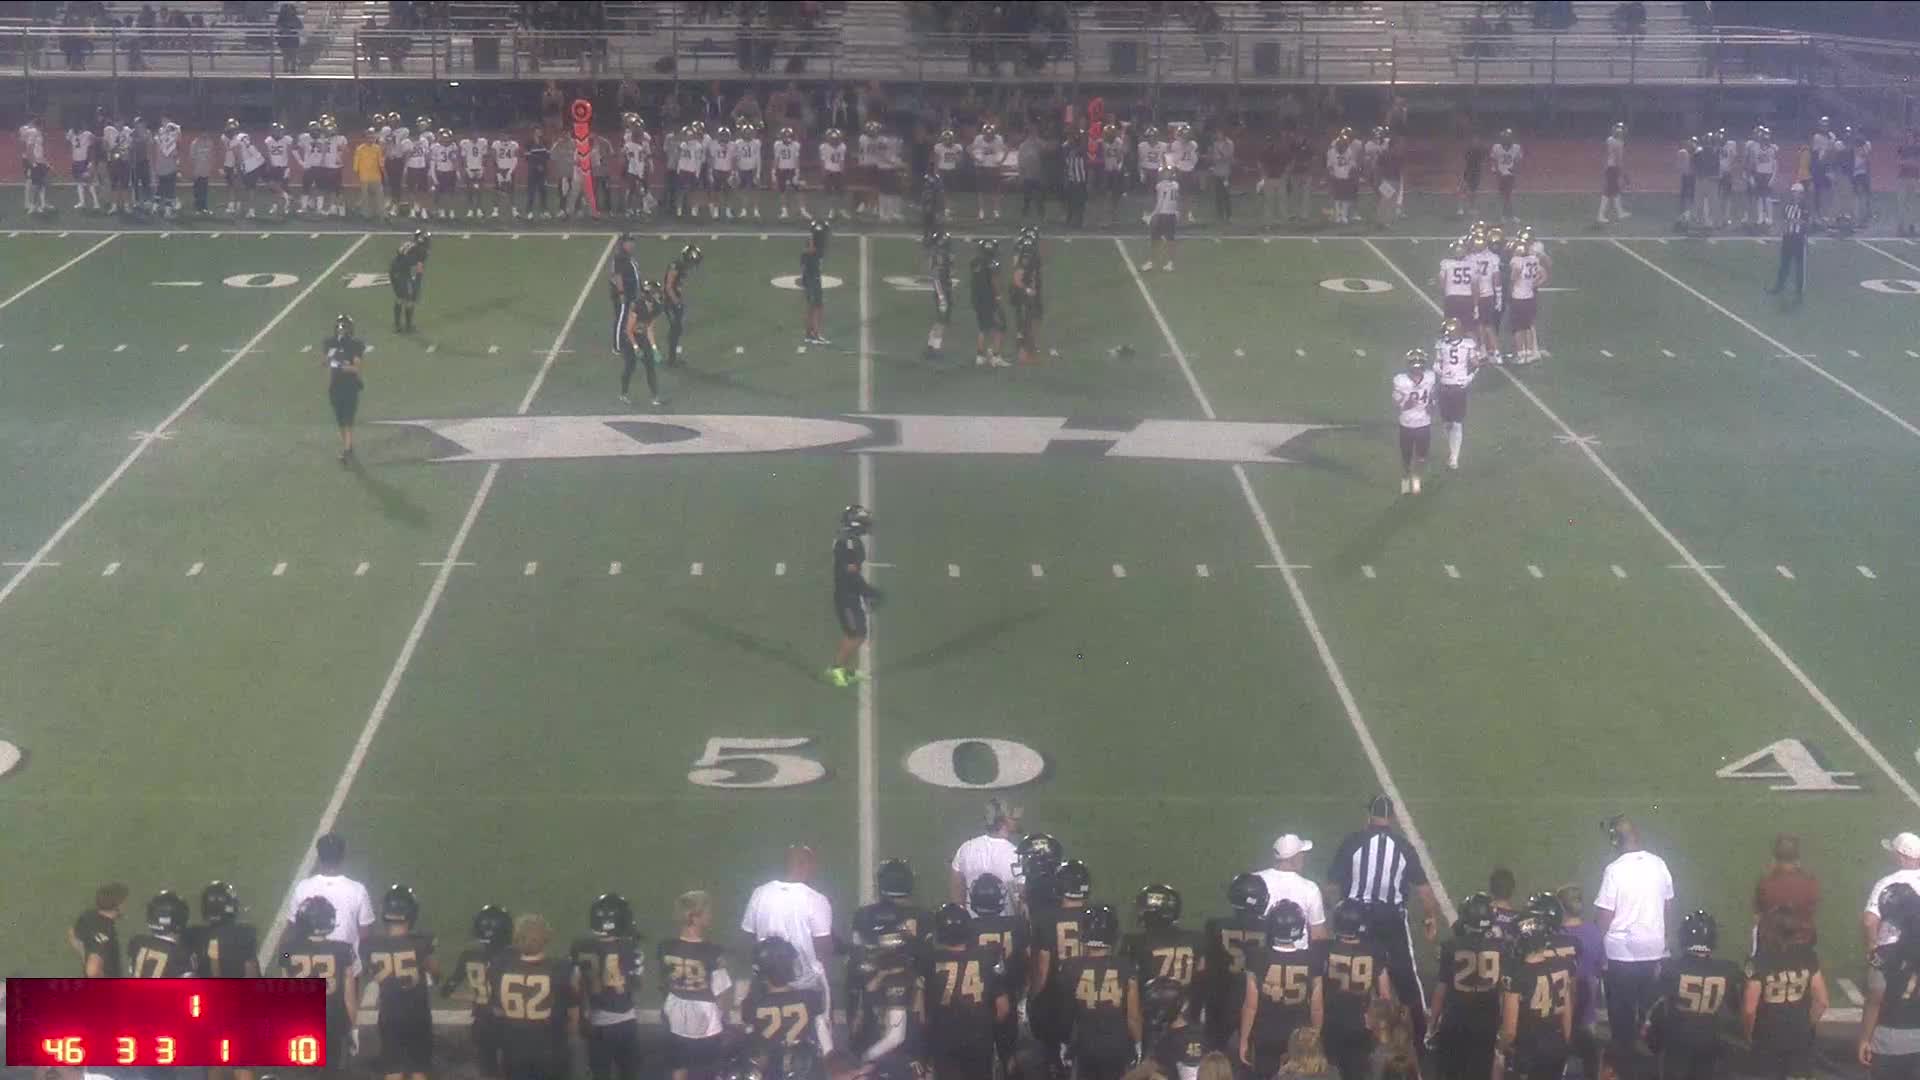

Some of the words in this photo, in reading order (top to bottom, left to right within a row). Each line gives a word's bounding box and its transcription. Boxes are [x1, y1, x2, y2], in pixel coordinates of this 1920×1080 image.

[1453, 267, 1471, 284] 55
[1449, 349, 1459, 365] 5
[1716, 738, 1861, 791] 4
[935, 959, 985, 1006] 74
[1152, 946, 1194, 987] 70
[1262, 964, 1309, 1005] 45
[1328, 953, 1374, 993] 59
[1454, 950, 1500, 992] 29
[500, 973, 552, 1020] 62
[1076, 968, 1124, 1009] 44
[1677, 974, 1727, 1015] 50
